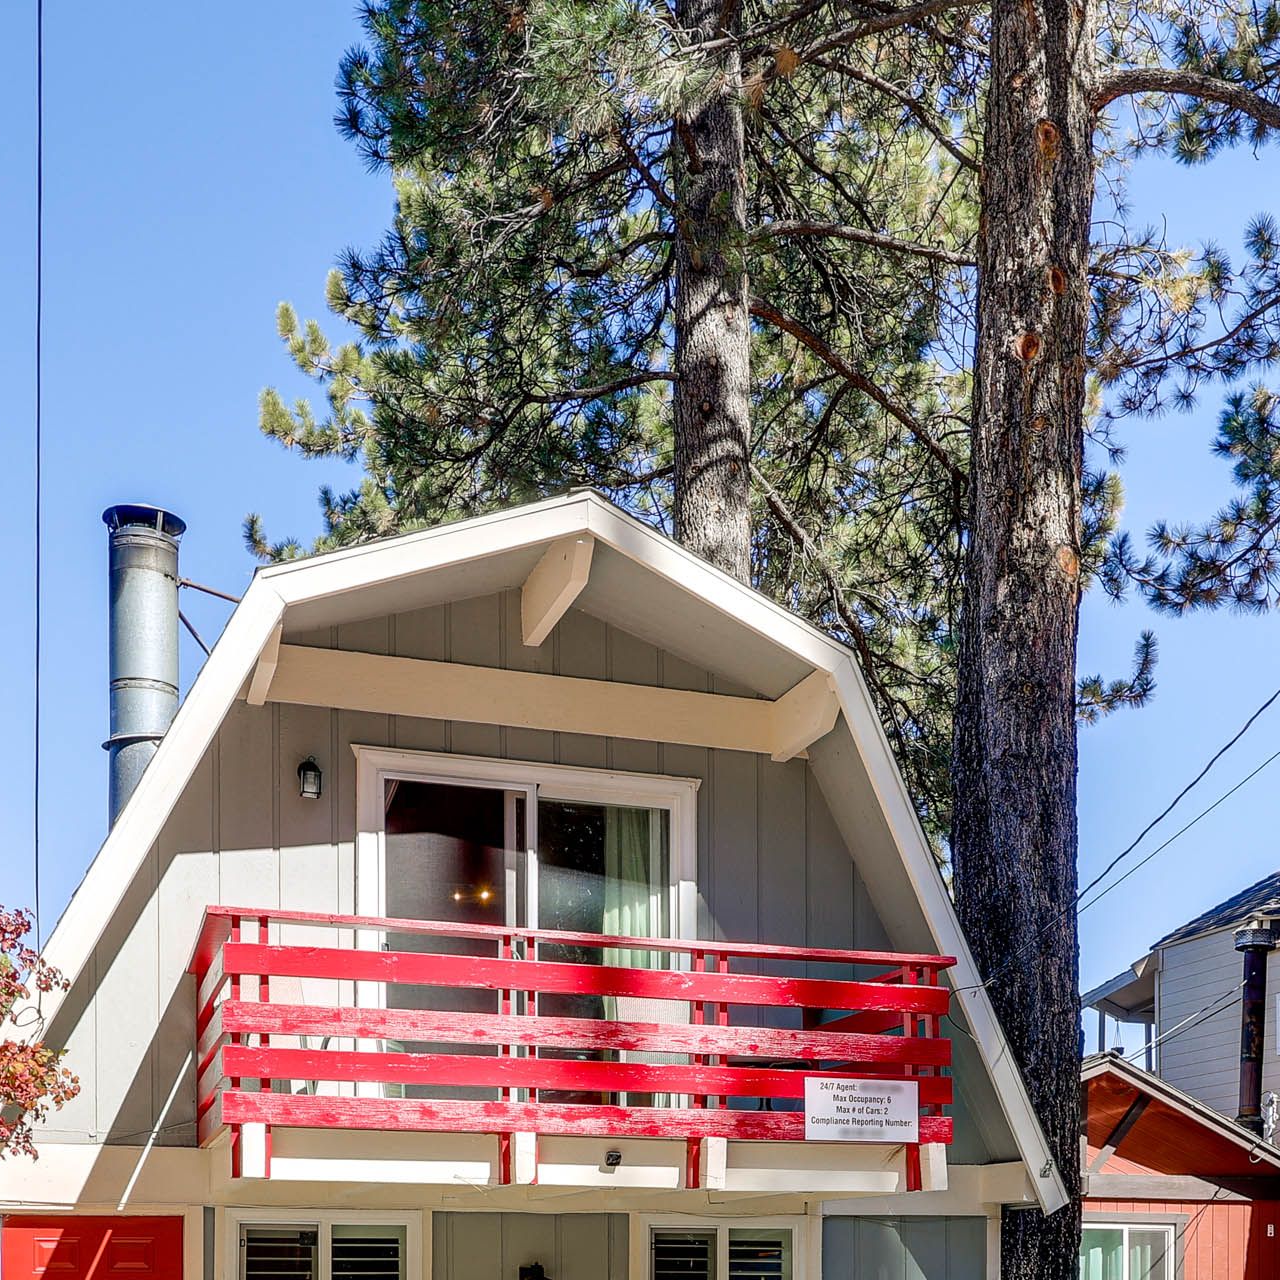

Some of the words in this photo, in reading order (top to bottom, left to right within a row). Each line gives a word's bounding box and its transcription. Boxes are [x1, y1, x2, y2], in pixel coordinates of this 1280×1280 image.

[820, 1082, 835, 1090] 24/7
[836, 1083, 857, 1092] Agent:
[833, 1094, 847, 1102] Max
[849, 1095, 886, 1104] Occupancy:
[836, 1106, 850, 1114] Max
[865, 1107, 883, 1115] Cars:
[884, 1107, 889, 1115] 2
[811, 1116, 850, 1126] Compliance
[852, 1117, 884, 1127] Reporting
[885, 1119, 913, 1127] Number:
